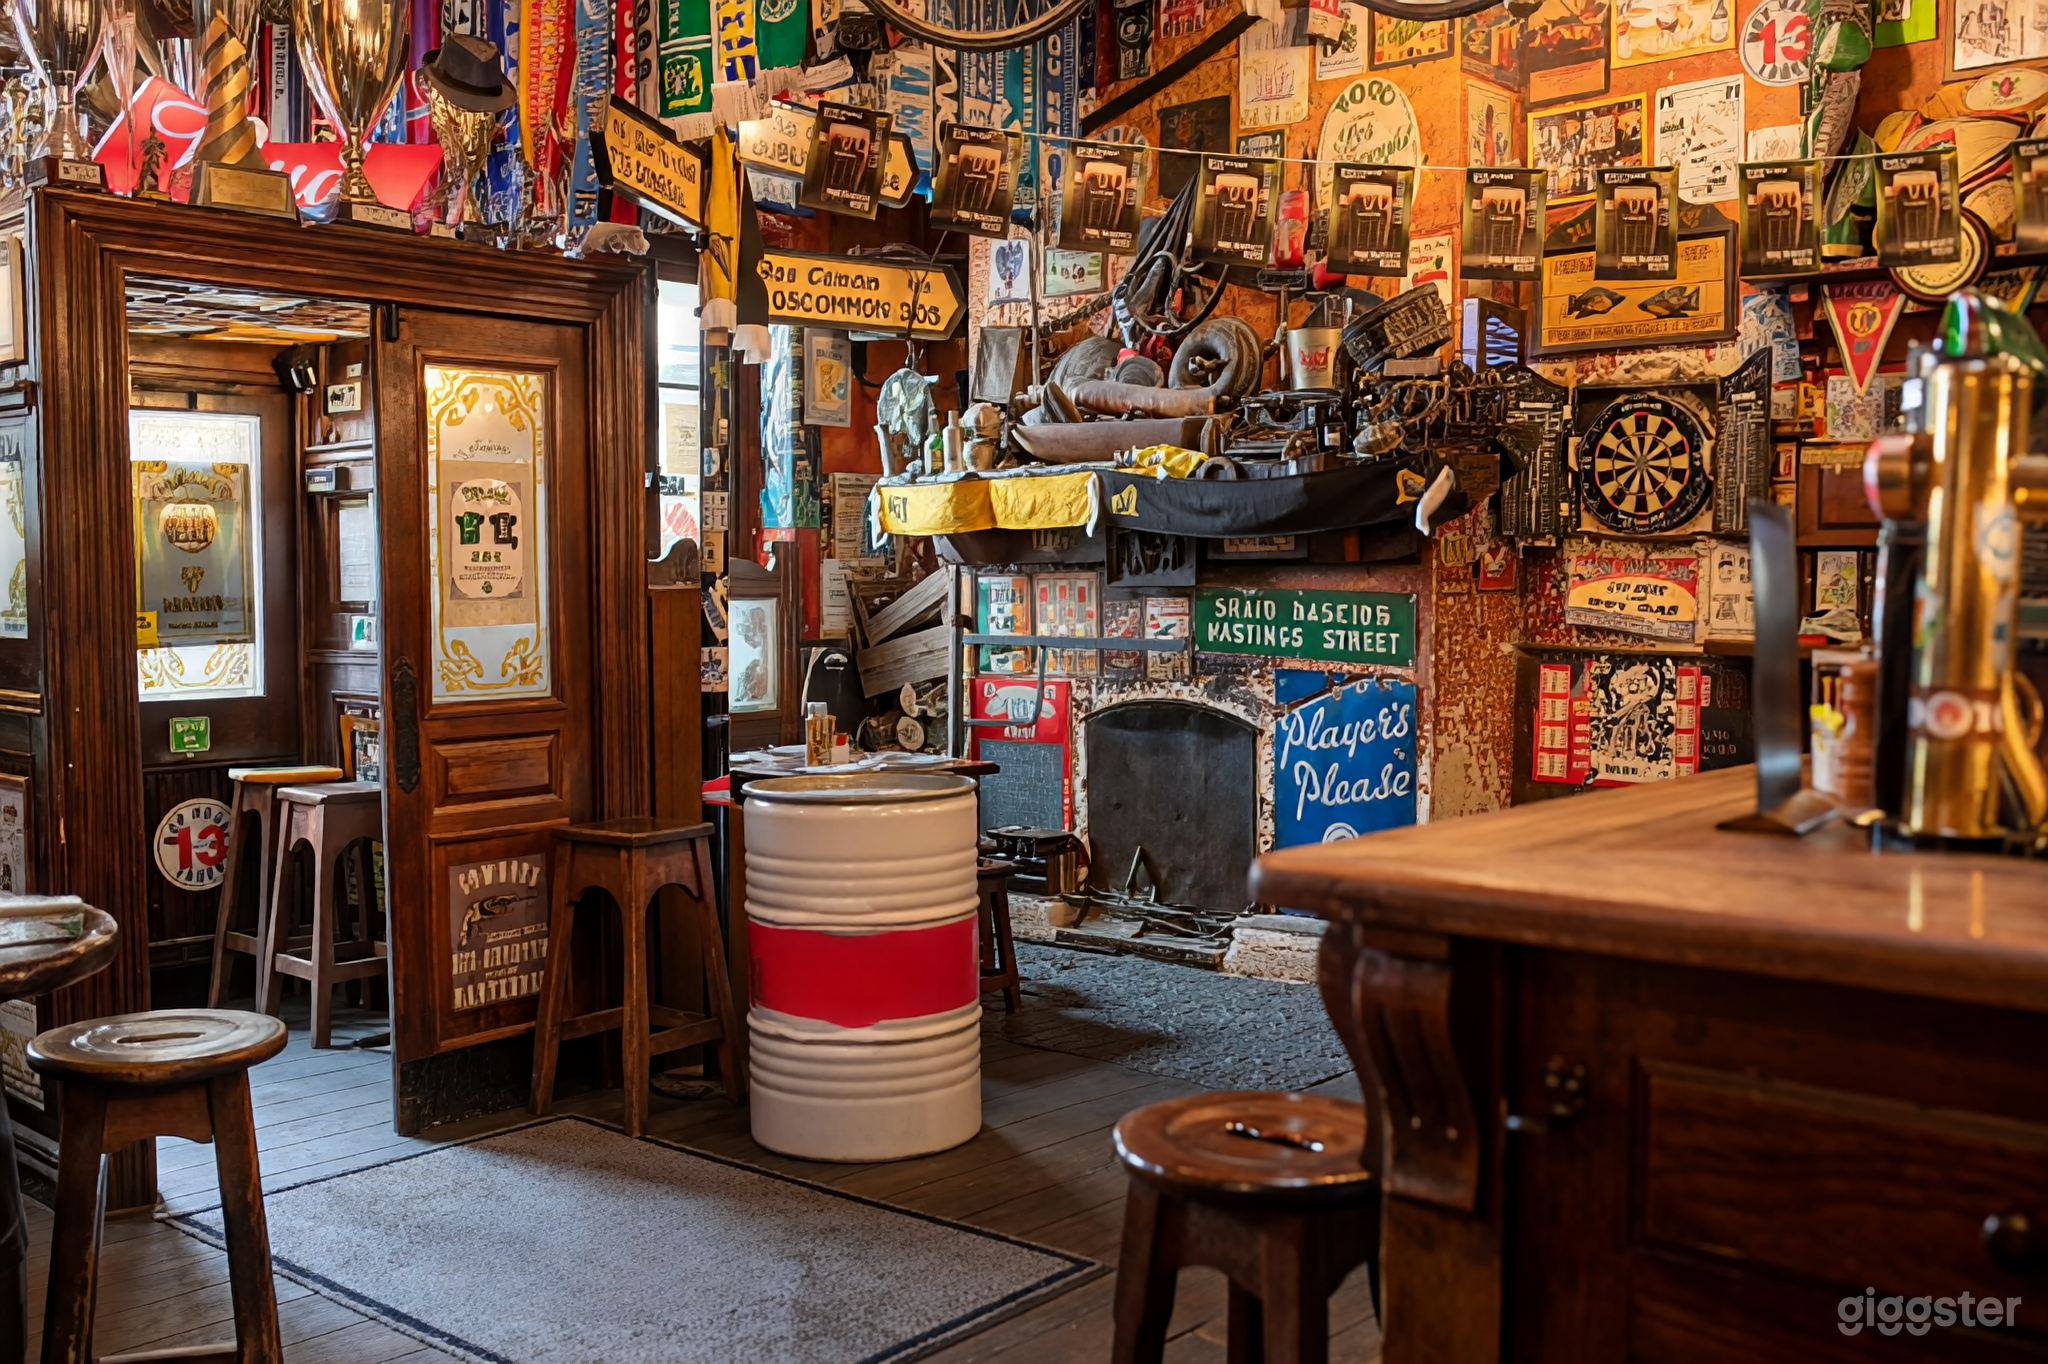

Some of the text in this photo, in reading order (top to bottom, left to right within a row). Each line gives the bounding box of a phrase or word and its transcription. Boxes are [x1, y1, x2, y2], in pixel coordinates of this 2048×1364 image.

[1323, 629, 1400, 655] STREET
[1280, 702, 1411, 770] Player's
[1294, 760, 1411, 822] Please
